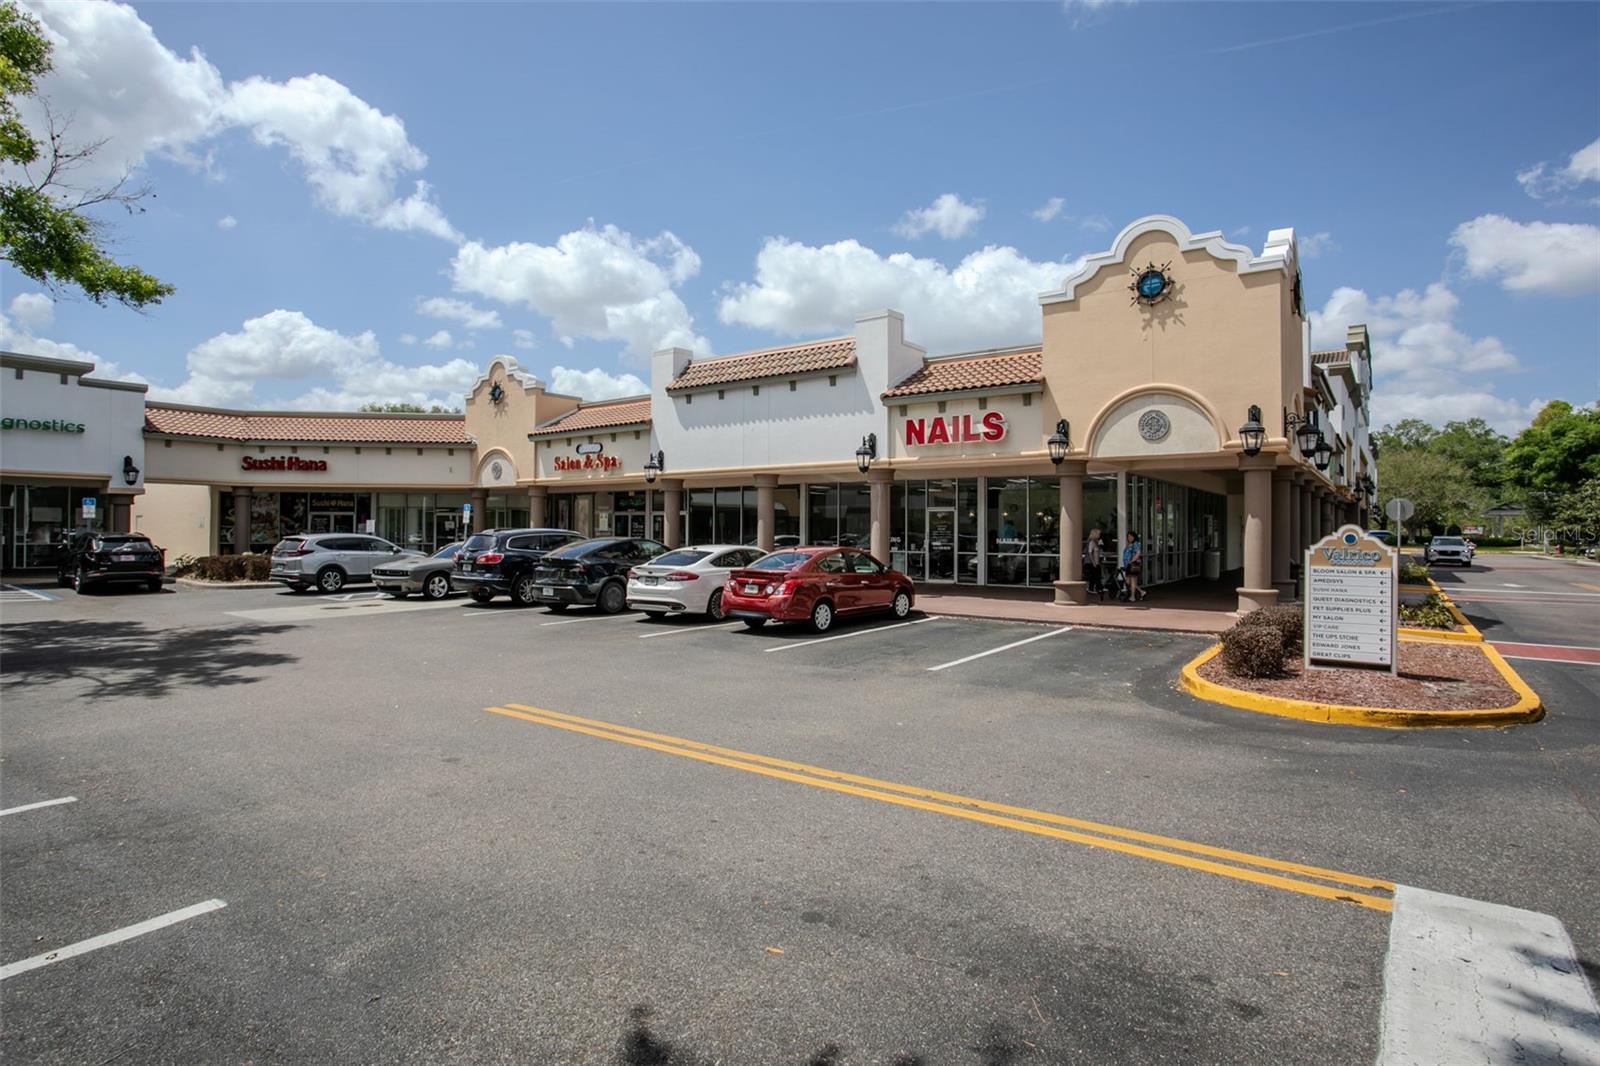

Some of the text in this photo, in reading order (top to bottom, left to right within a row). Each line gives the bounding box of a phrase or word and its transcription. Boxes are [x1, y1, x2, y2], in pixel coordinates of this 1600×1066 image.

[0, 417, 86, 434] gnostics
[905, 411, 1005, 446] NAILS
[241, 456, 328, 471] Sushi Hana
[554, 453, 618, 472] Salon & Spa
